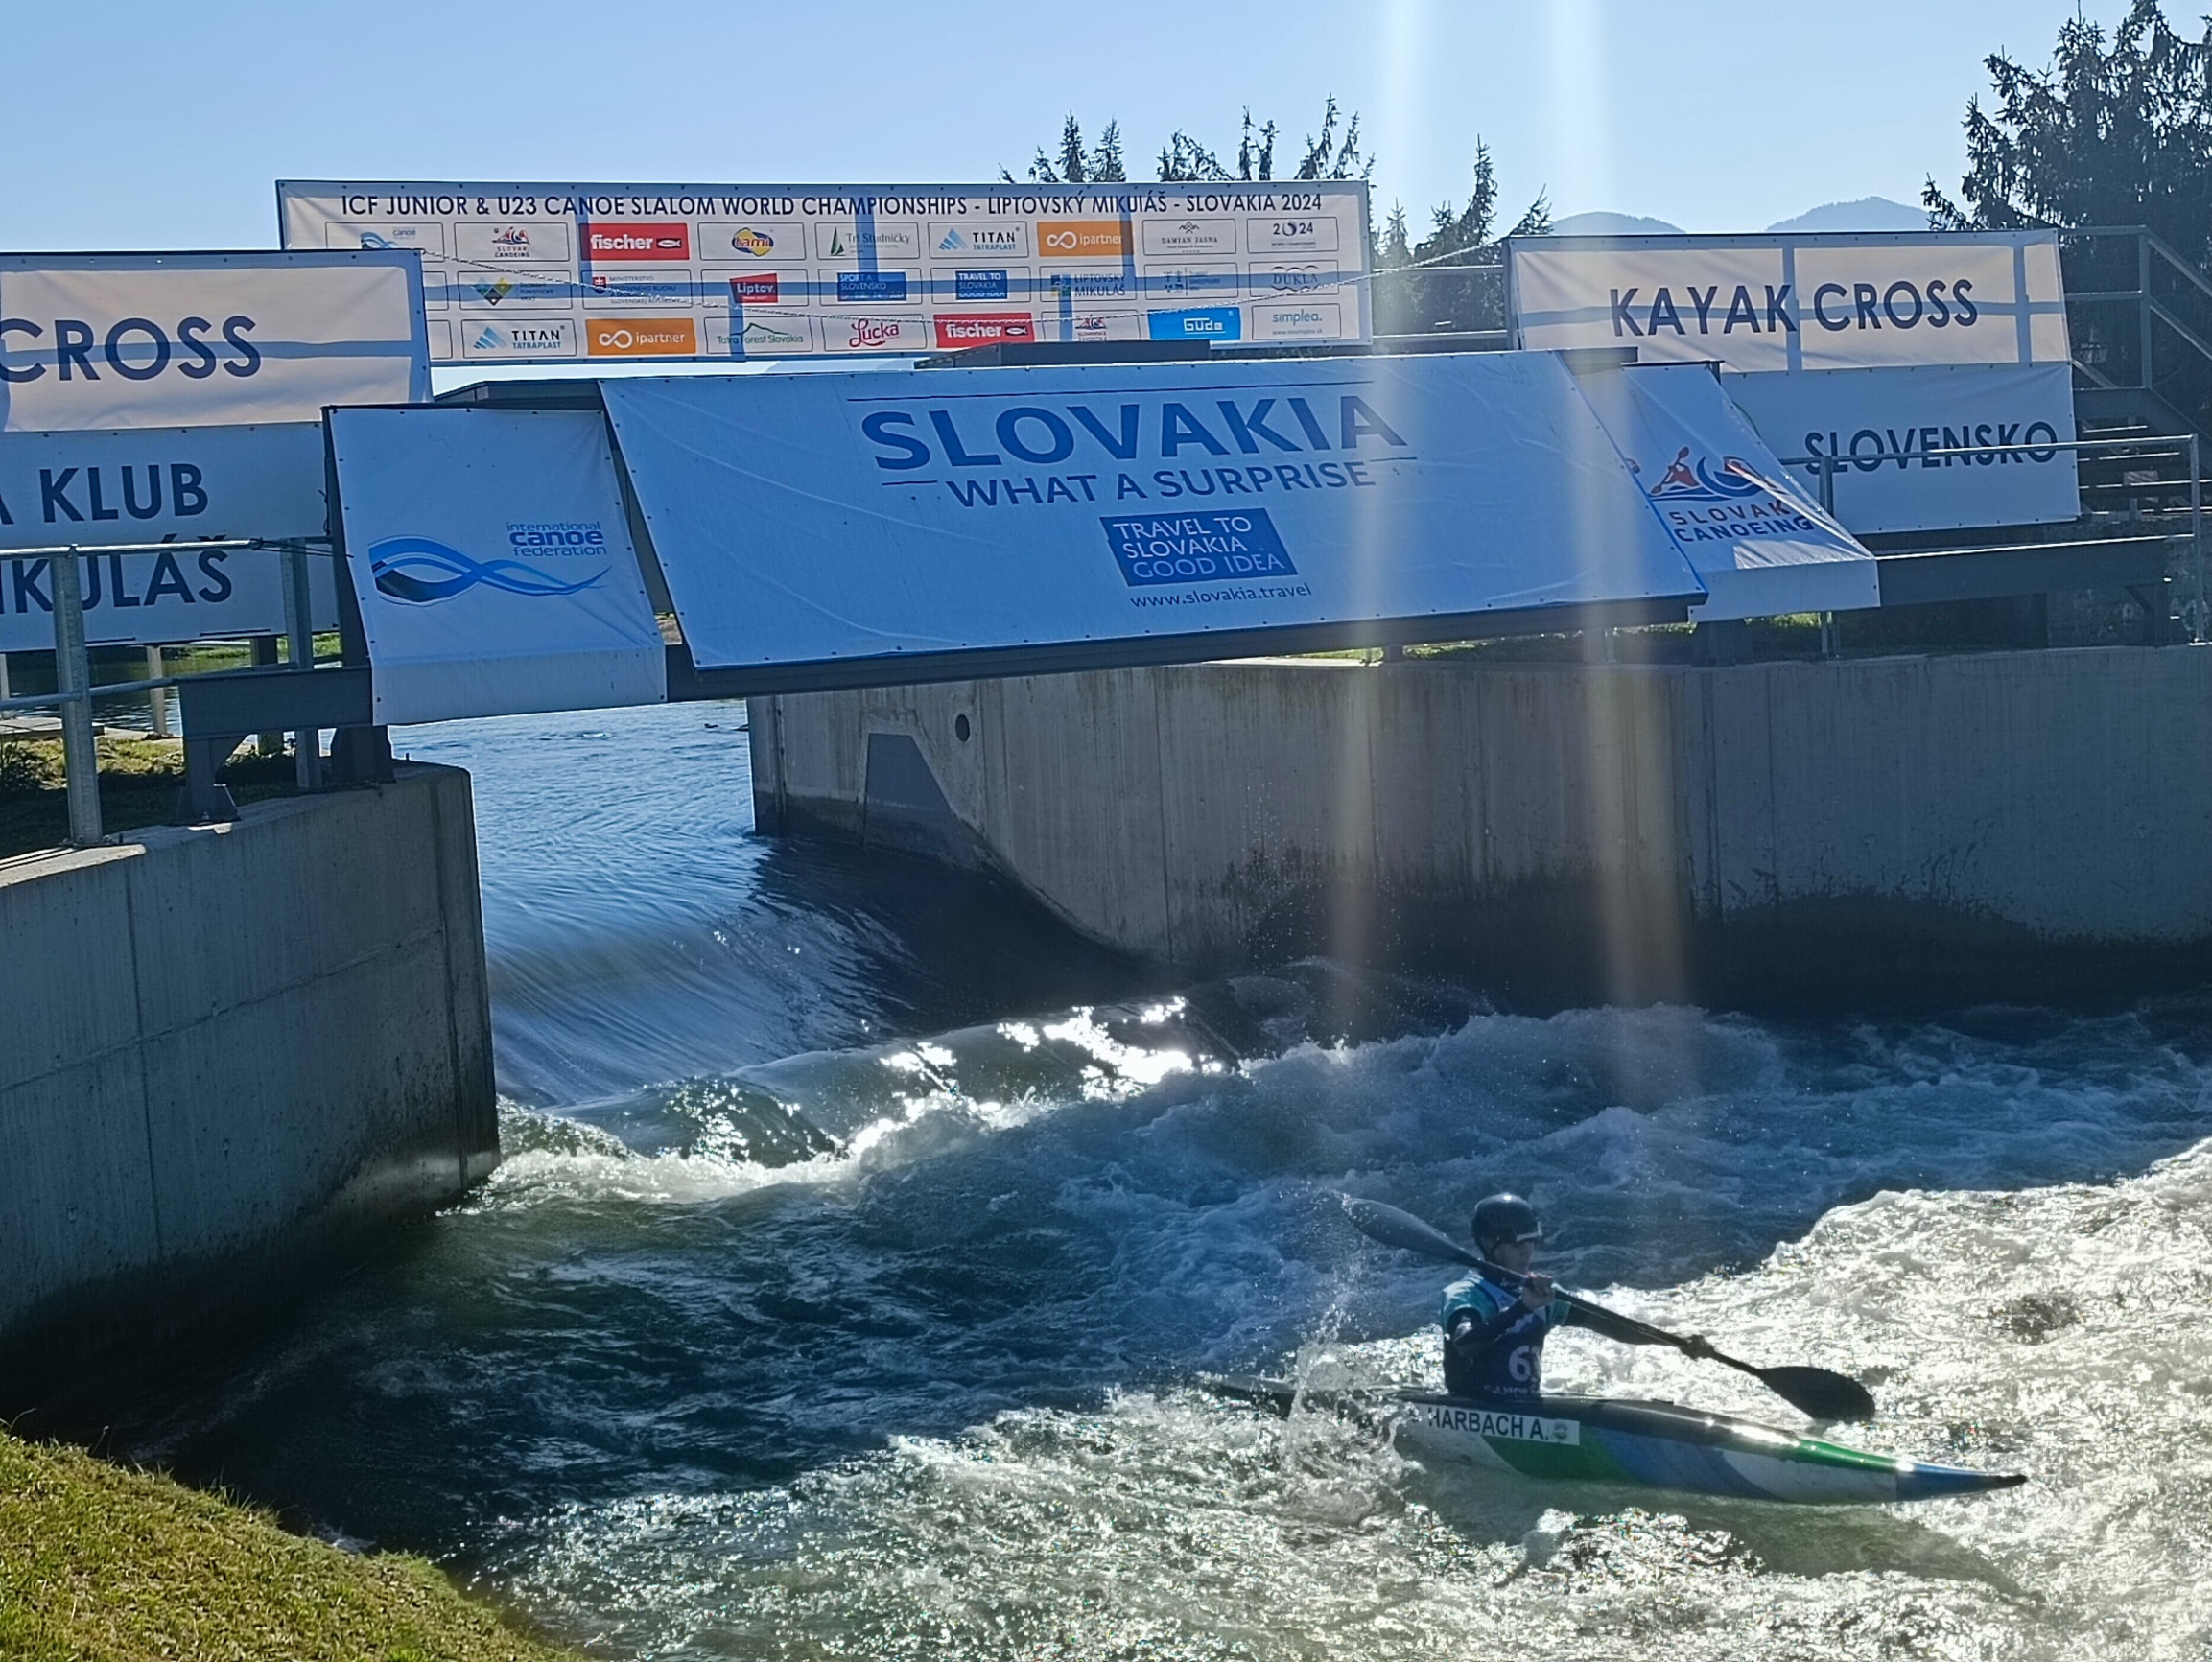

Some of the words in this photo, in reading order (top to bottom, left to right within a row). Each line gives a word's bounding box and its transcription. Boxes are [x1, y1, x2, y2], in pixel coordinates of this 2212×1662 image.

[341, 195, 378, 215] ICF
[386, 195, 468, 215] JUNIOR
[476, 196, 490, 215] &
[497, 196, 537, 215] U23
[544, 196, 624, 216] CANOE
[631, 196, 716, 215] SLALOM
[721, 196, 795, 215] WORLD
[802, 196, 967, 215] CHAMPIONSHIPS
[988, 191, 1086, 214] LIPTOVSKÝ
[1186, 194, 1276, 213] SLOVAKIA
[1281, 193, 1322, 211] 2024
[590, 233, 653, 250] fischer
[973, 232, 1016, 244] TITAN
[1079, 232, 1123, 246] ipartner
[959, 272, 987, 281] TRAVEL
[1273, 273, 1319, 285] DUKLA
[737, 282, 774, 295] Liptov
[959, 281, 998, 290] SLOVAKIA
[1074, 283, 1126, 297] MIKULÁŠ
[1610, 284, 1799, 338] KAYAK
[1813, 279, 1978, 332] CROSS
[511, 330, 560, 341] TITAN
[636, 332, 685, 344] ipartner
[767, 334, 804, 343] Slovakia
[946, 323, 1001, 338] fischer
[861, 395, 1408, 470] SLOVAKIA
[1804, 421, 2059, 476] SLOVENSKO
[946, 473, 1097, 508] WHAT
[1117, 472, 1148, 501] A
[1159, 460, 1377, 497] SURPRISE
[39, 463, 208, 523] KLUB
[1669, 501, 1792, 526] SLOVAK
[506, 522, 601, 532] international
[1113, 518, 1211, 540] TRAVEL
[1213, 516, 1252, 533] TO
[1673, 514, 1815, 543] CANOEING
[509, 530, 604, 547] canoe
[512, 545, 607, 557] federation
[1122, 536, 1249, 559] SLOVAKIA
[1132, 557, 1217, 579] GOOD
[1224, 552, 1285, 574] IDEA
[1130, 582, 1312, 608] www.slovakia.travel
